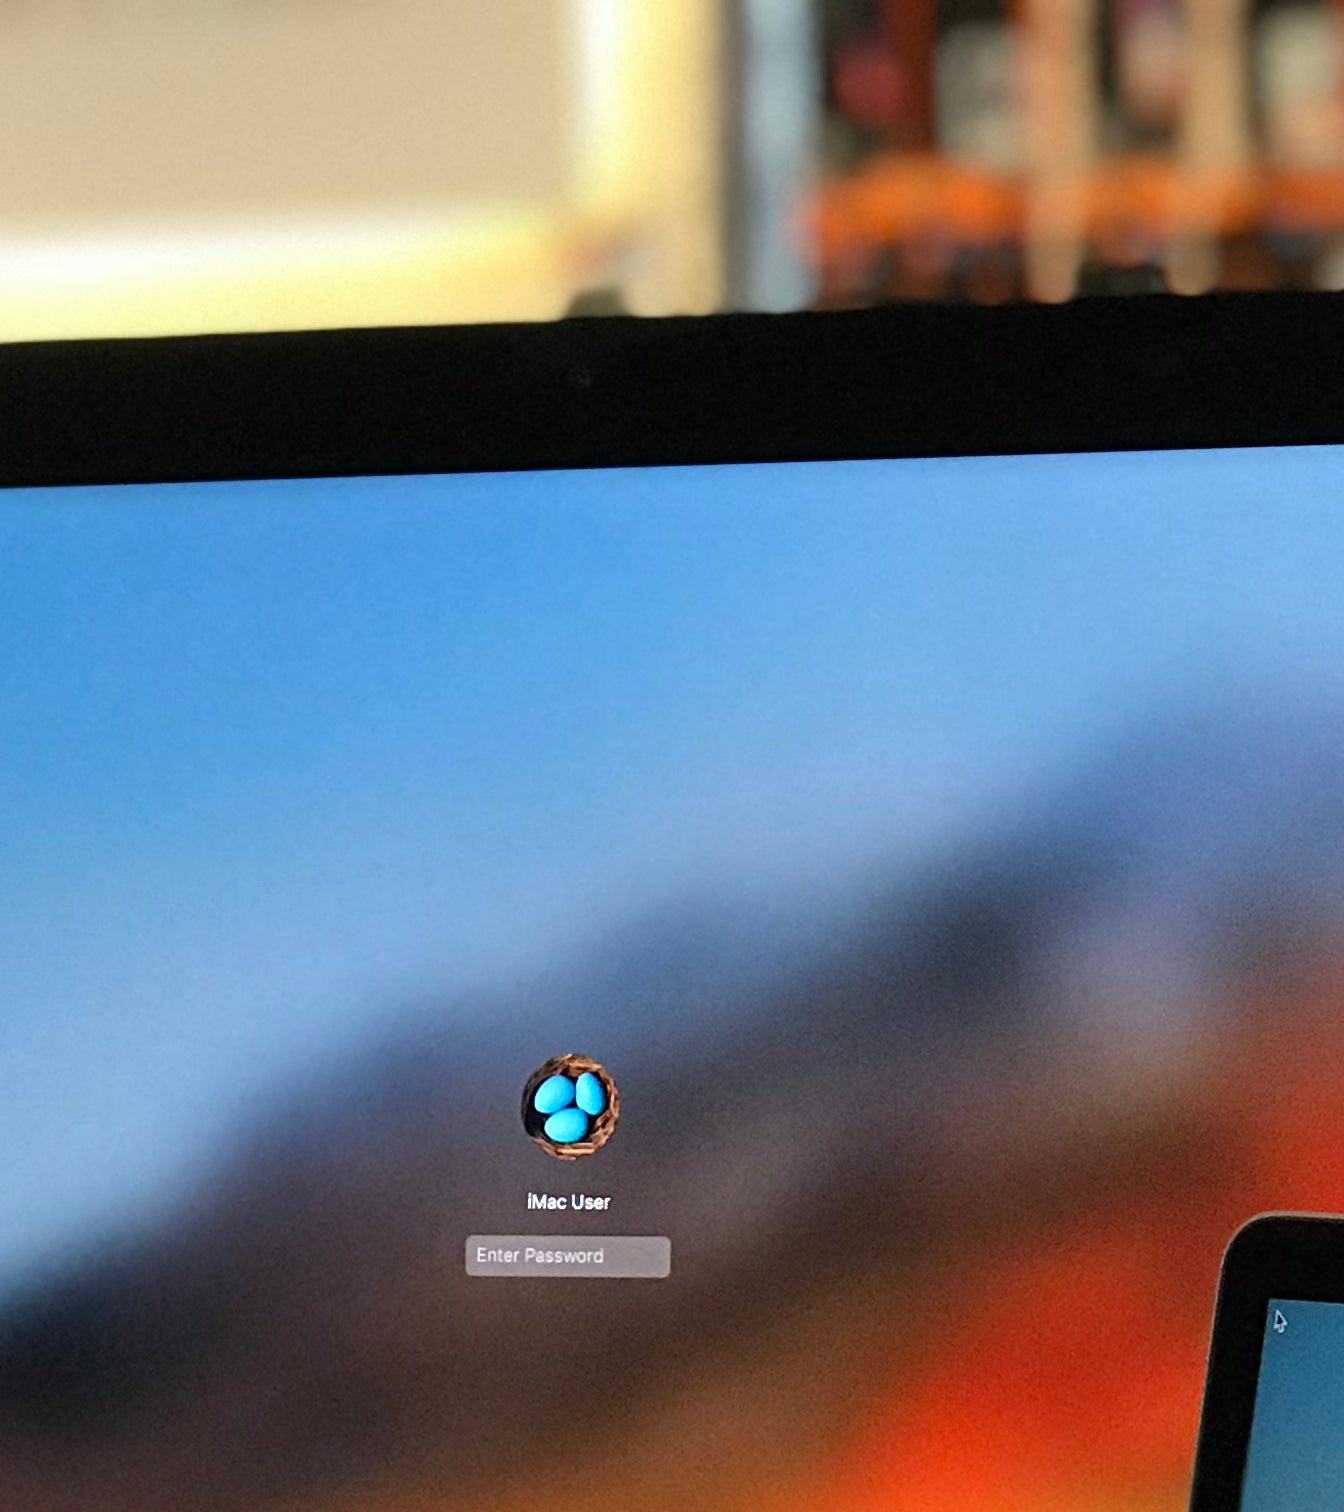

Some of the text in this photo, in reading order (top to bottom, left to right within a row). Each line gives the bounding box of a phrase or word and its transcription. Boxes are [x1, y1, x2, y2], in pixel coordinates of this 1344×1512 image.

[527, 1192, 611, 1210] iMac User
[476, 1246, 604, 1264] Enter Password
